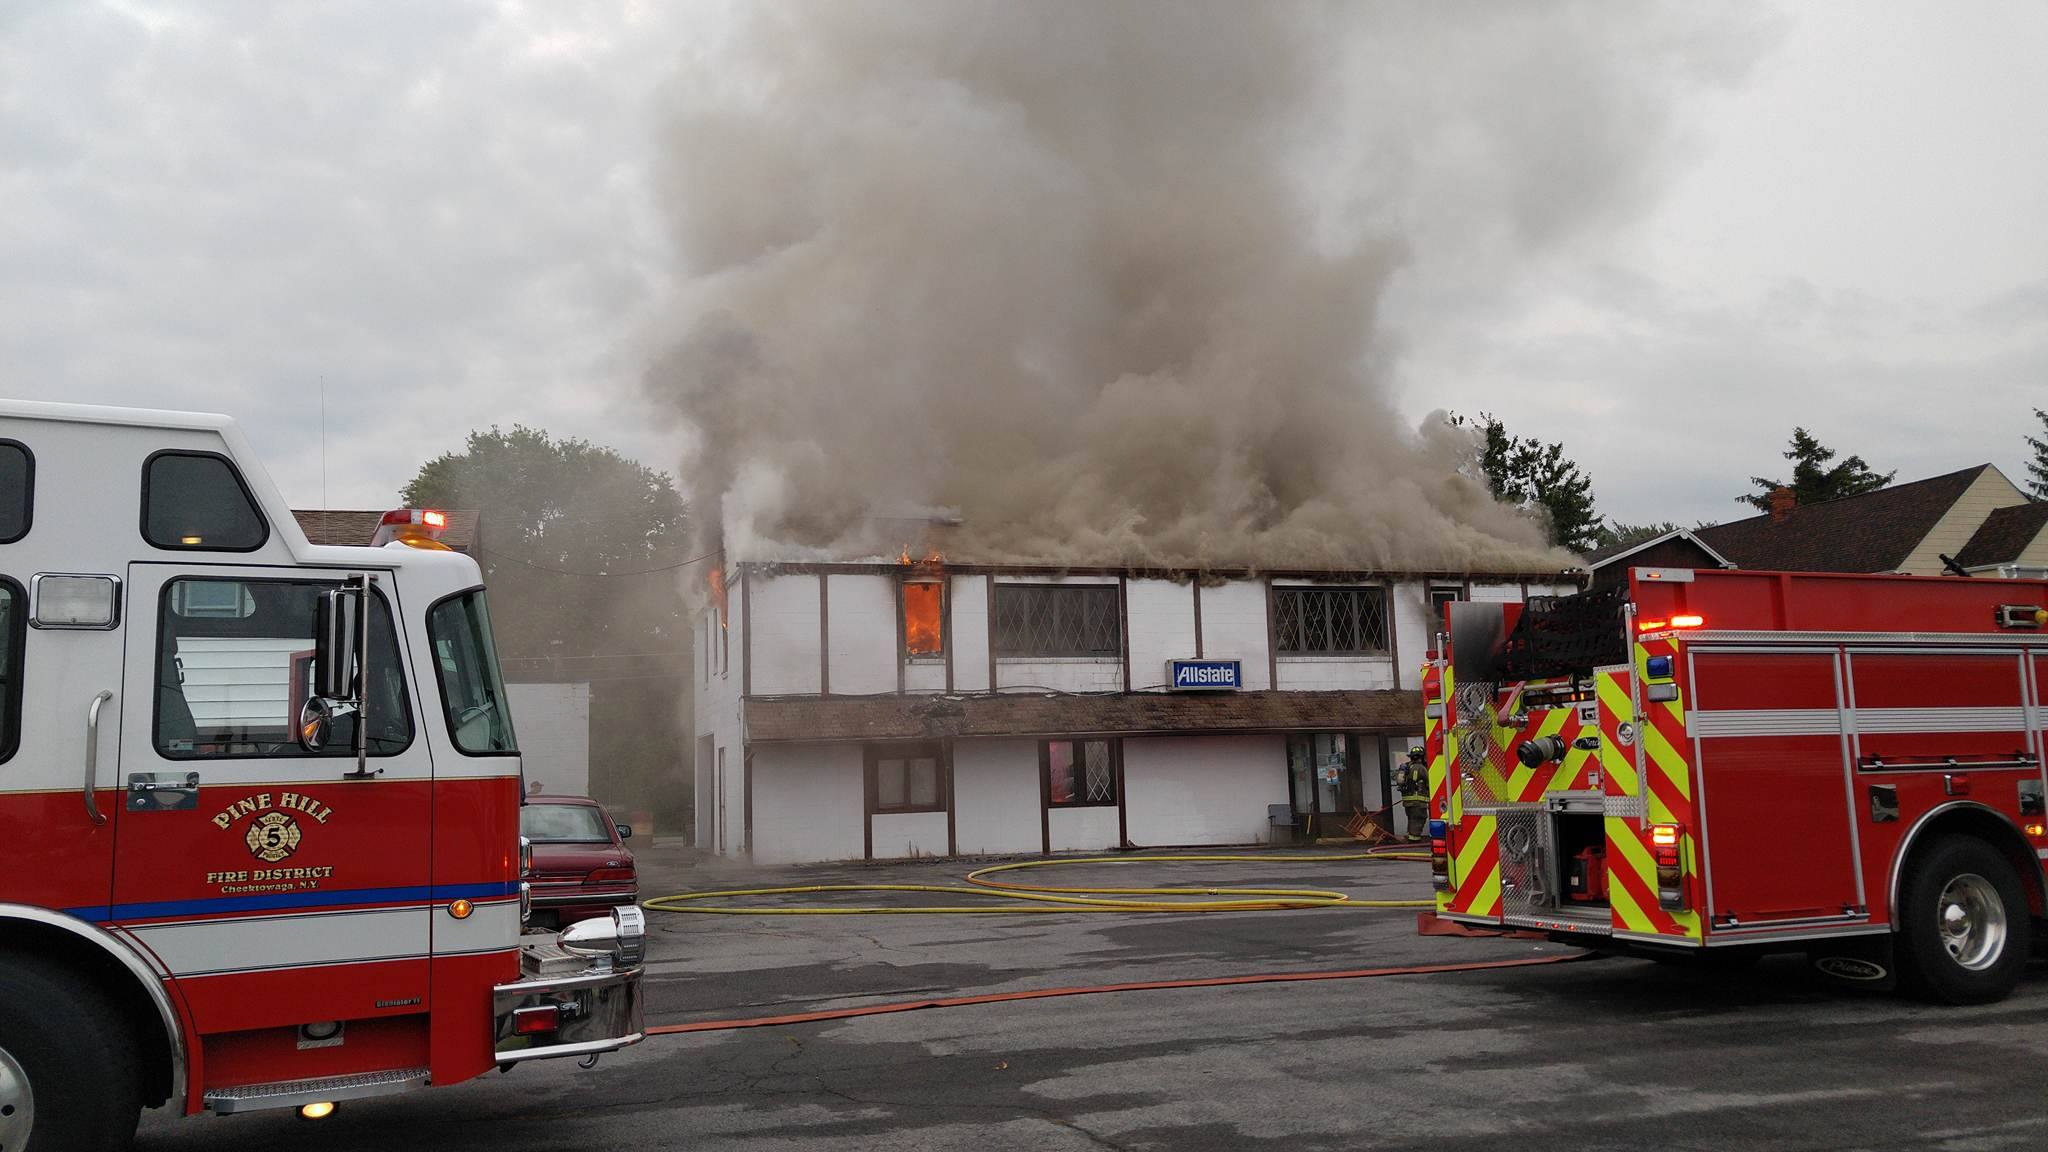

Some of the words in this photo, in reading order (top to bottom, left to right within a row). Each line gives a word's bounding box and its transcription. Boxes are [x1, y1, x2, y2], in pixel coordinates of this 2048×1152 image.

[1177, 667, 1234, 683] Allstate
[211, 793, 272, 830] PINE
[279, 792, 333, 824] HILL
[266, 827, 281, 848] 5
[207, 870, 248, 883] FIRE
[253, 866, 334, 881] DISTRICT
